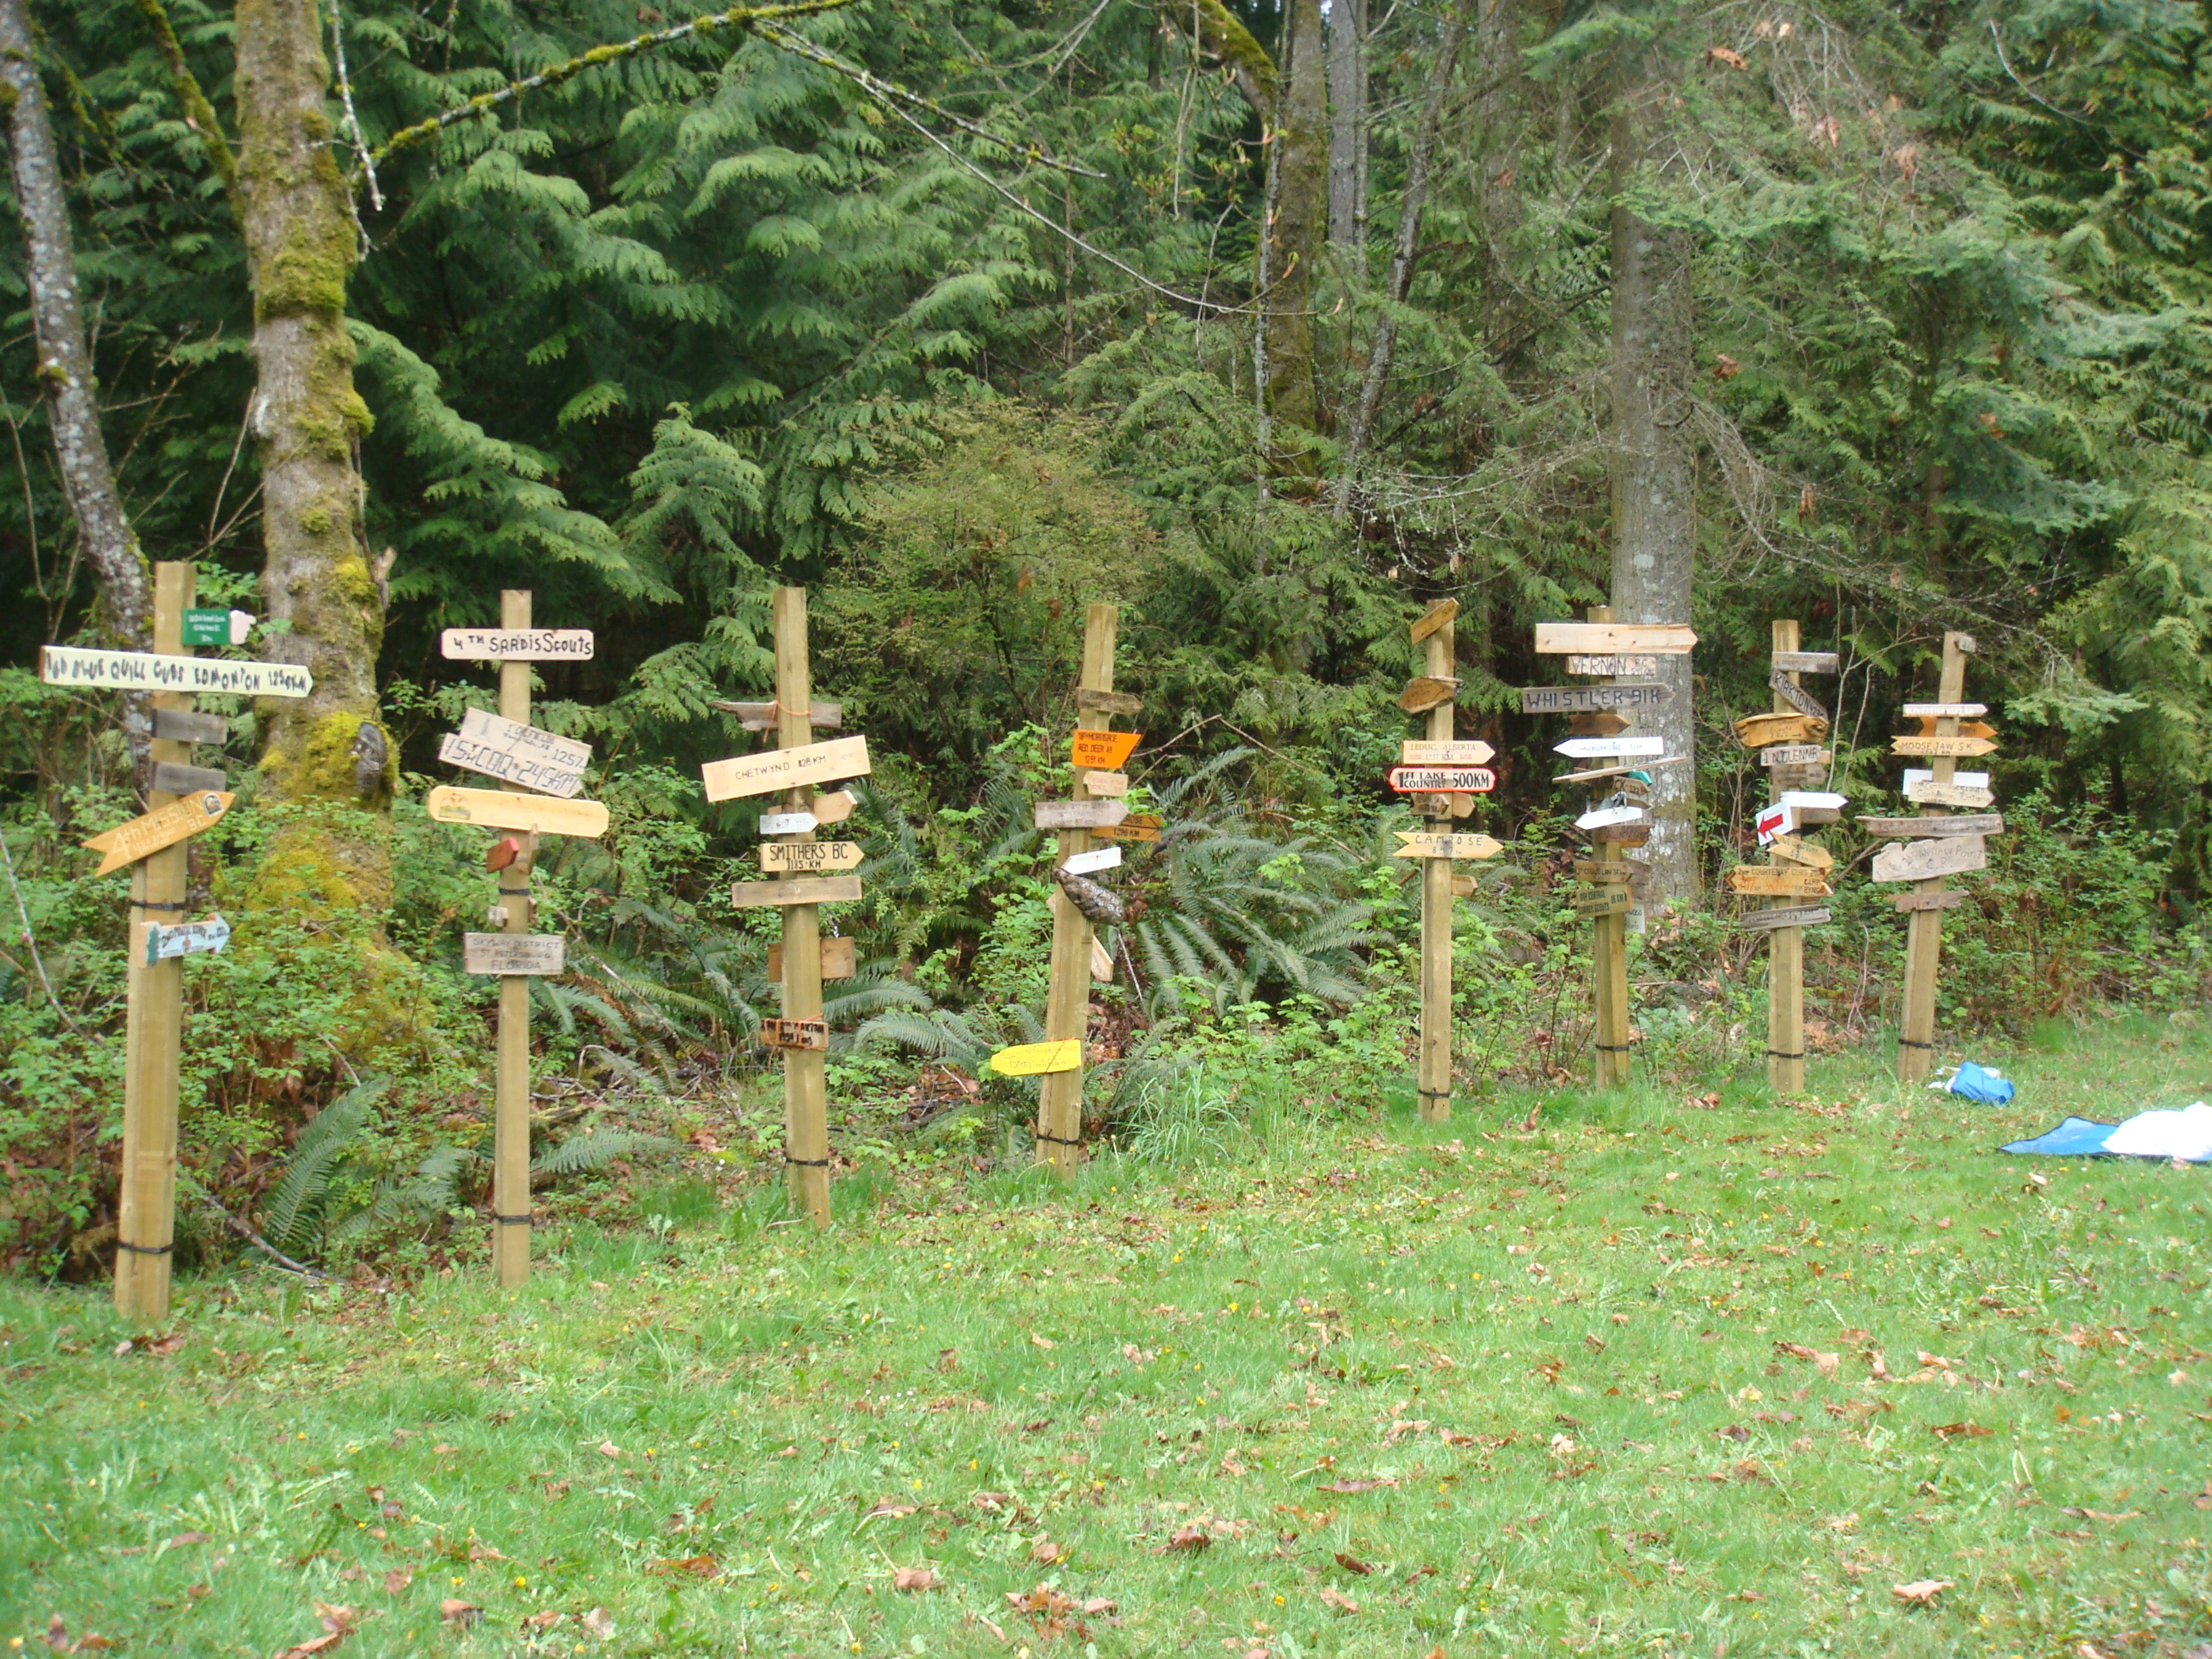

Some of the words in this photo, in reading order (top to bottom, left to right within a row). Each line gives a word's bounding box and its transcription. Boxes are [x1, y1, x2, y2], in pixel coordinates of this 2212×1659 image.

[1570, 656, 1626, 676] VERNON
[111, 657, 146, 682] QUILL
[154, 660, 184, 684] CUBS
[194, 667, 261, 691] EDMONTON
[1527, 690, 1623, 708] WHISTLER
[1078, 743, 1088, 752] RED
[1090, 744, 1104, 752] DEER
[1900, 742, 1931, 750] MOOSE
[1936, 742, 1954, 751] JAW
[735, 762, 790, 780] CHETWYND
[813, 754, 826, 766] KM
[1404, 780, 1446, 788] COUNTRY
[1453, 773, 1489, 788] 500KM
[140, 798, 205, 835] MISSION
[1128, 830, 1140, 838] KM
[1415, 836, 1482, 846] CAMROSE
[770, 844, 826, 861] SMITHERS
[832, 843, 848, 859] BC
[808, 860, 821, 868] KM
[1751, 868, 1788, 876] COURTENAY
[514, 939, 560, 949] DISTRICT
[491, 960, 542, 970] FLORIDA
